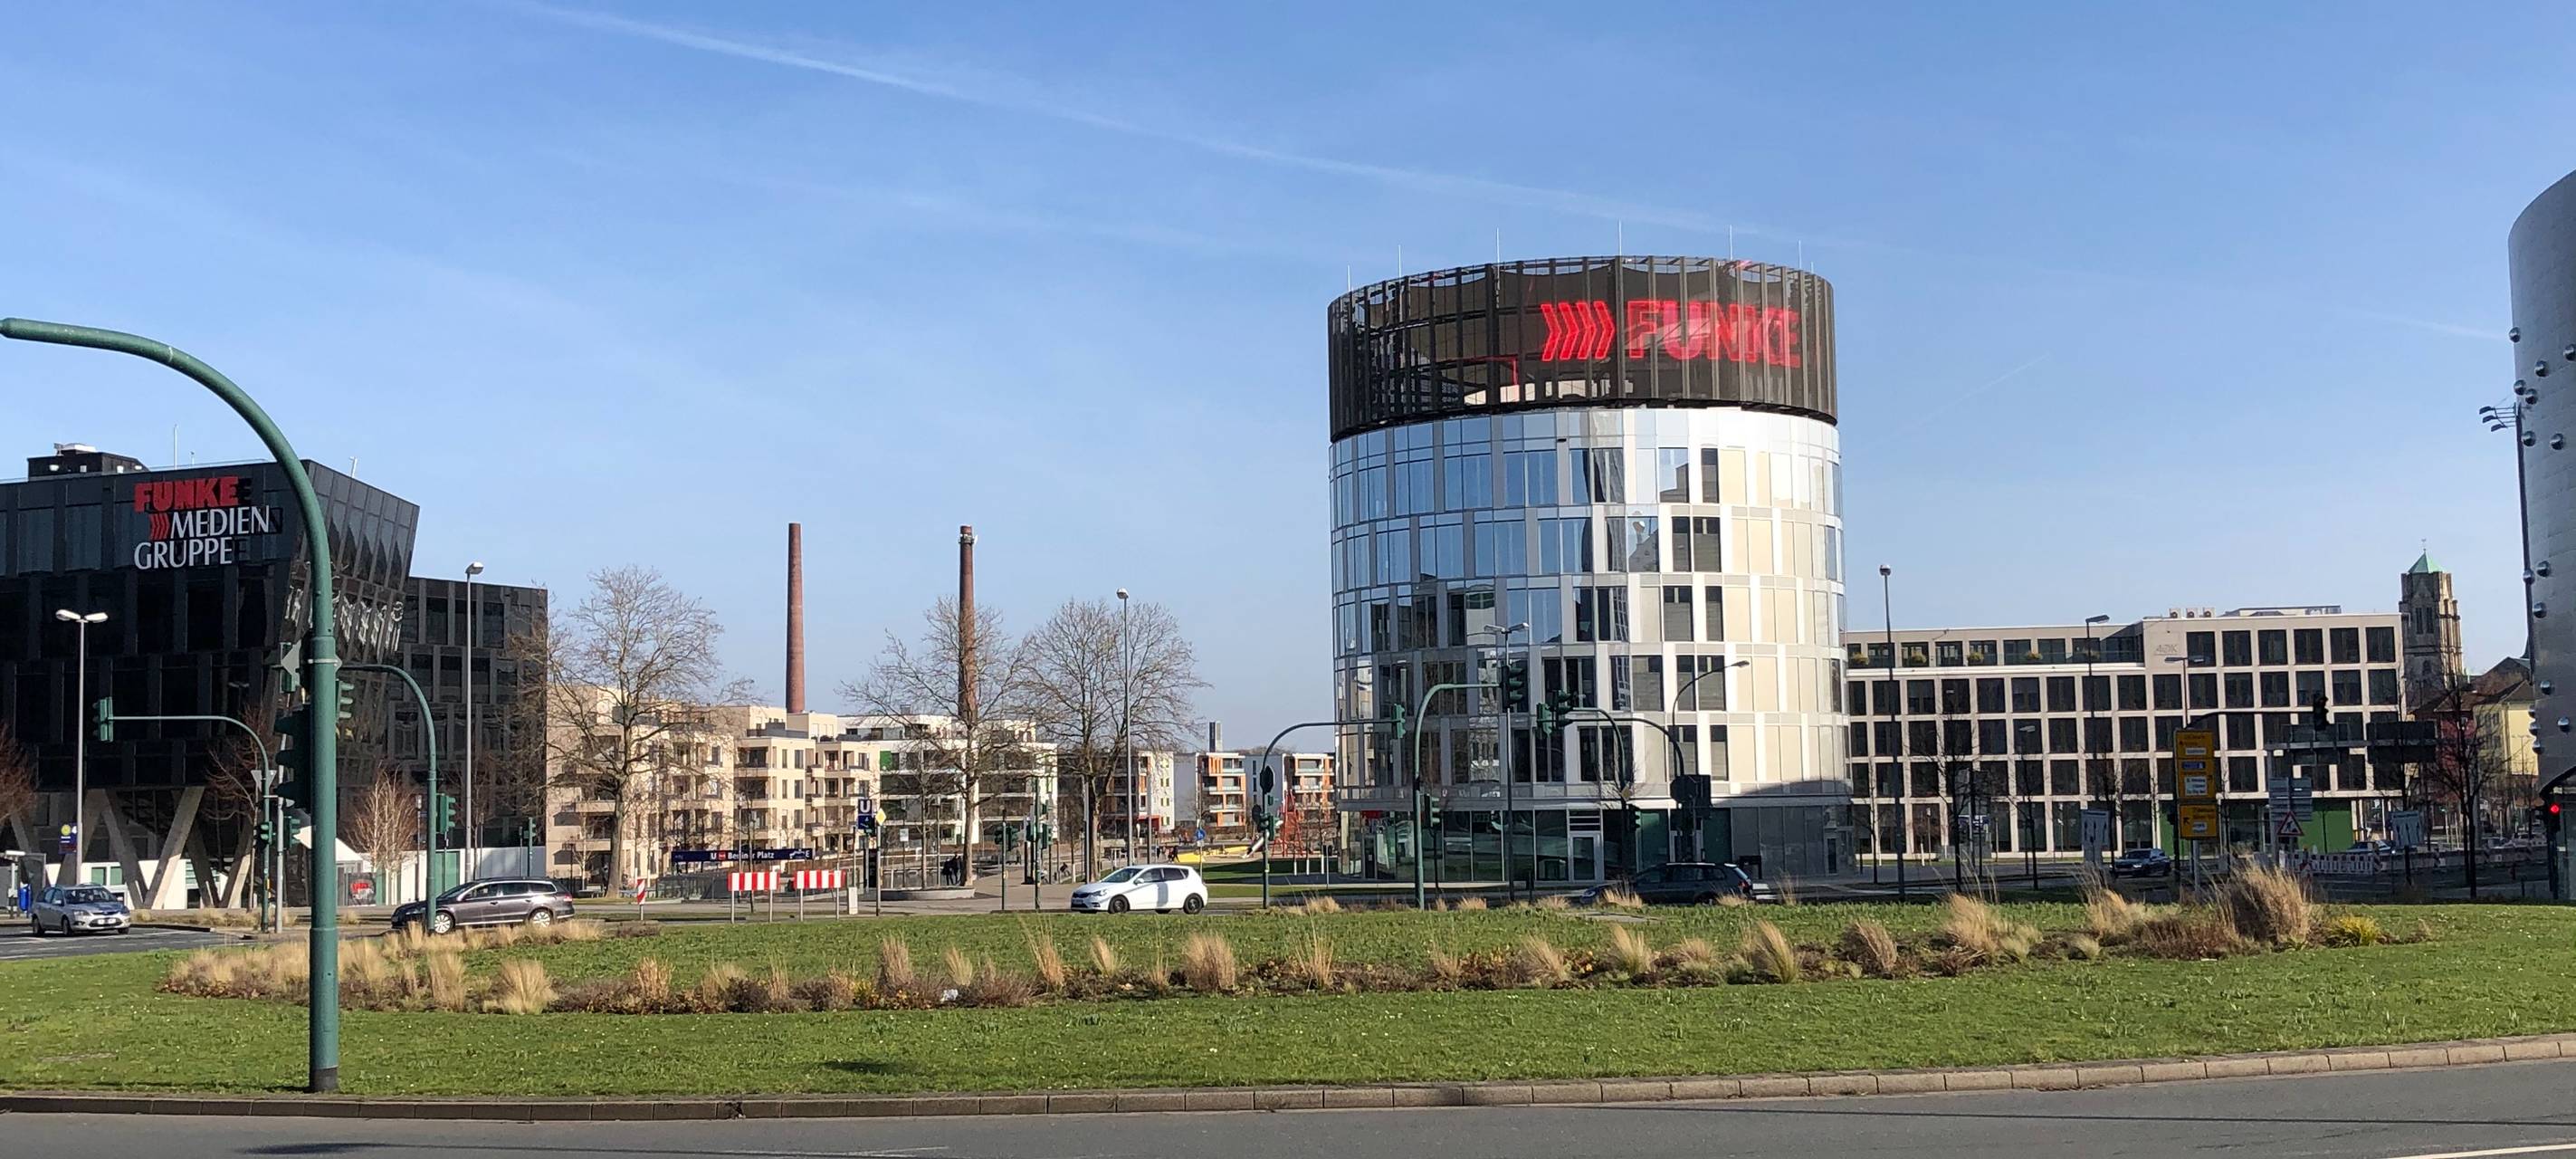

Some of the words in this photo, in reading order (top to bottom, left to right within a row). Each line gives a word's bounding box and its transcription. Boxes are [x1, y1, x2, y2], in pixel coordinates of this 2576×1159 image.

[1627, 300, 1800, 368] FUNKE
[134, 476, 238, 512] FUNKE
[170, 505, 270, 539] MEDIEN
[134, 537, 233, 570] GRUPPE
[860, 800, 871, 813] U
[711, 852, 717, 860] U
[728, 852, 755, 860] Berinr
[757, 851, 775, 859] Platz
